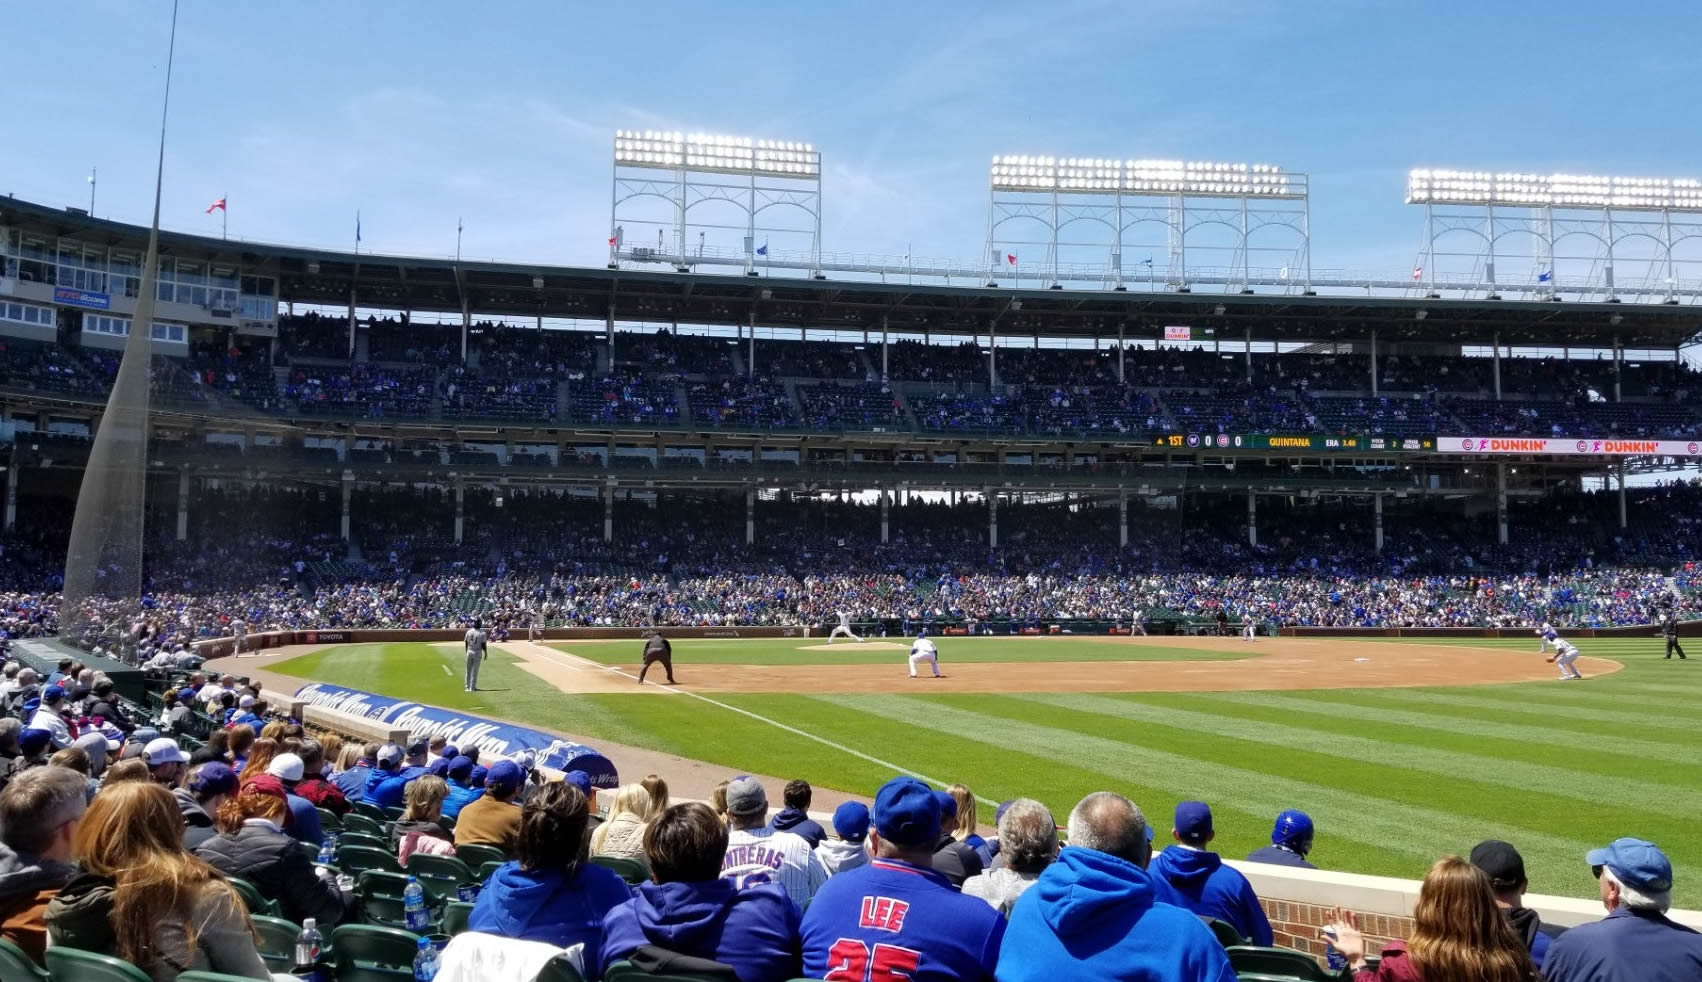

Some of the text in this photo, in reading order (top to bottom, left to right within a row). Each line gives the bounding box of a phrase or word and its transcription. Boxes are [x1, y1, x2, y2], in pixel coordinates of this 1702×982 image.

[1168, 435, 1183, 446] 1ST
[1205, 435, 1211, 446] 0
[1235, 436, 1241, 447] 0
[1269, 437, 1310, 447] QUINTANA
[1326, 439, 1339, 447] ERA
[1491, 440, 1547, 451] DUNKIN'
[1604, 441, 1659, 453] DUNKIN'
[859, 896, 910, 933] LEE
